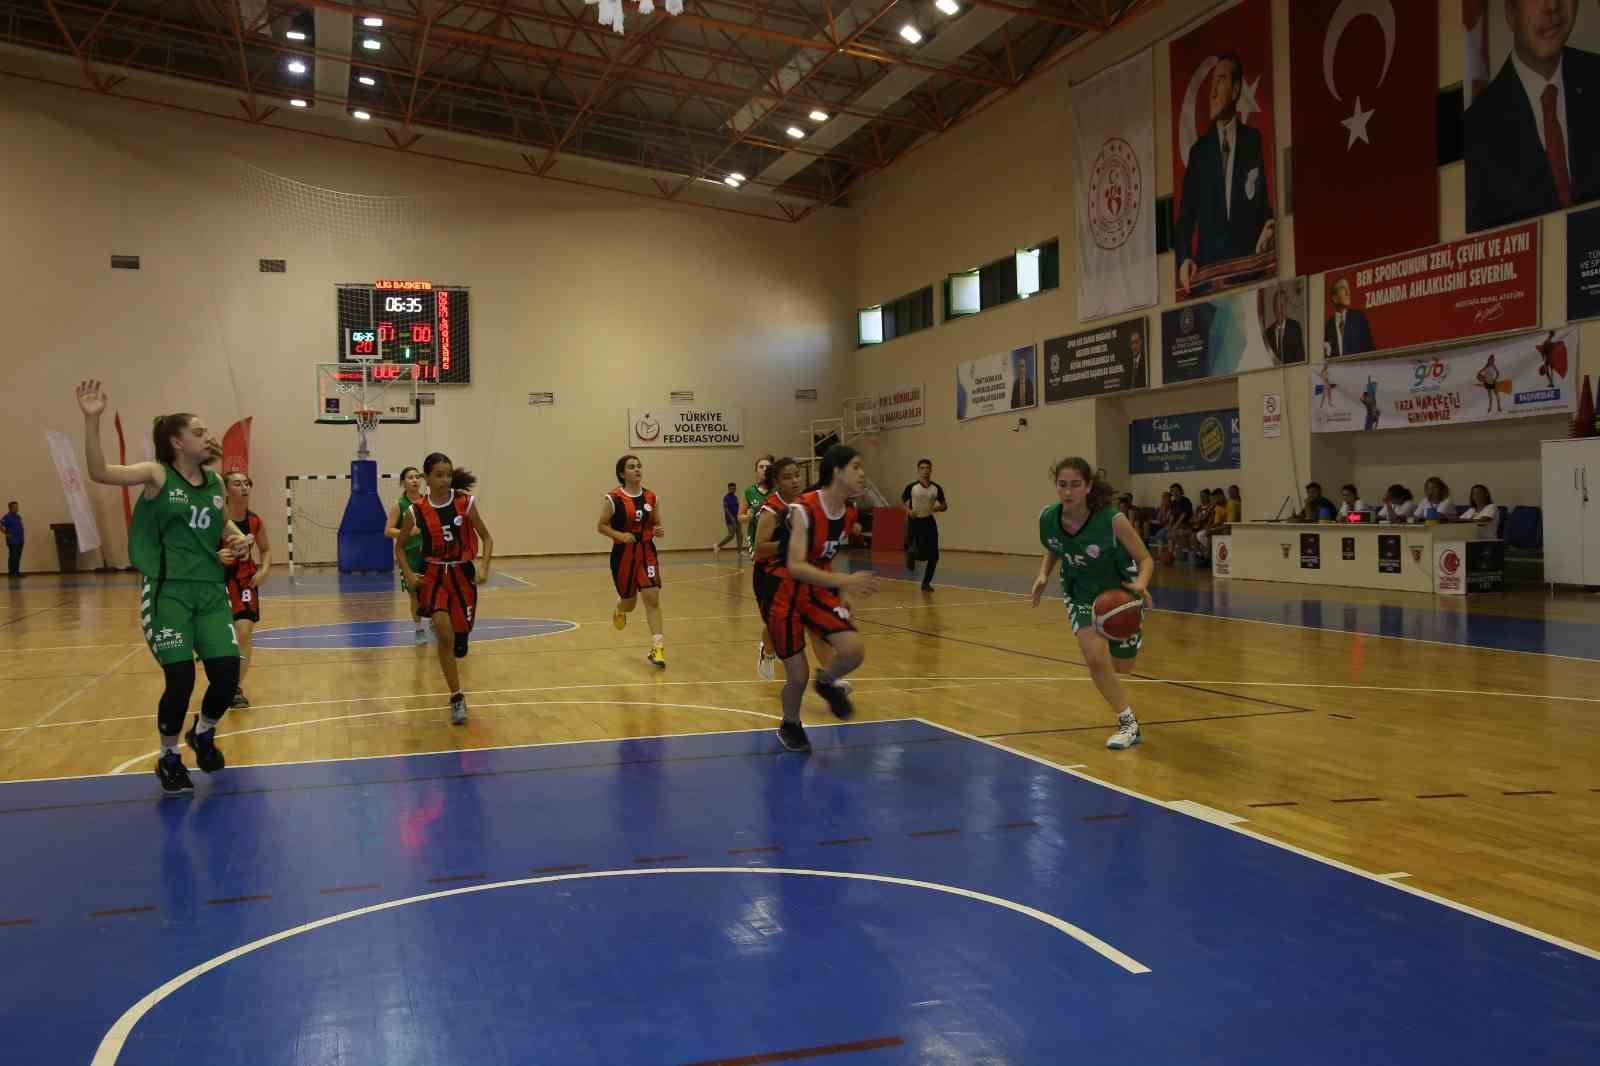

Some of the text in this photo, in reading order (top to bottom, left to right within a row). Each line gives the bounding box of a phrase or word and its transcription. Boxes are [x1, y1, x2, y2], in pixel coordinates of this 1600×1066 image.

[1356, 232, 1530, 287] BEN SPORCUNUN ZEKİ, ÇEVİK VE AYNI
[1365, 259, 1518, 309] ZAMANDA AHLAKLISINI SEVERİM.
[385, 297, 422, 312] 06:35
[680, 410, 722, 422] TÜRKİYE
[674, 423, 728, 433] VOLEYBOL
[663, 434, 740, 443] FEDERASYONU
[189, 505, 210, 529] 16
[443, 524, 454, 542] 5
